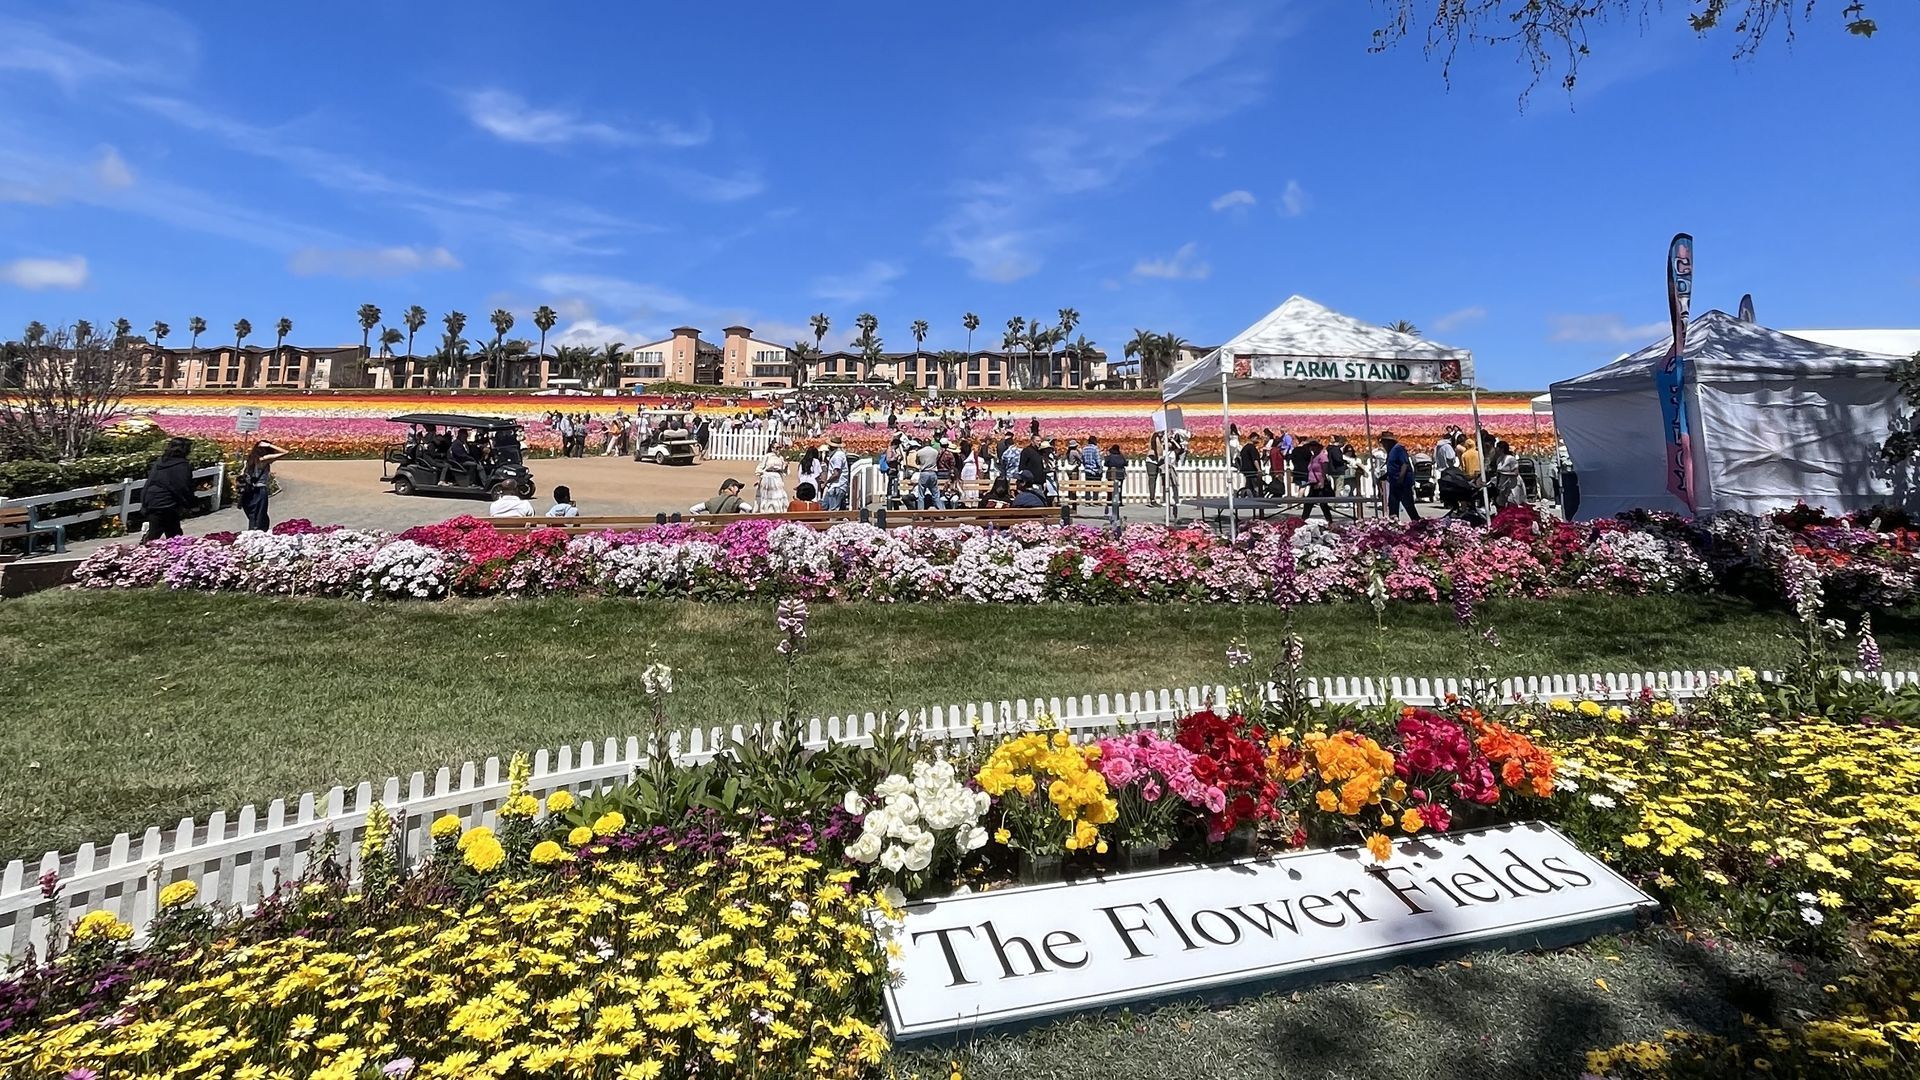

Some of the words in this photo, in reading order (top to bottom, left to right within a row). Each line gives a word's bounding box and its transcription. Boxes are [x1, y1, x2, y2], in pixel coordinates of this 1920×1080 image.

[1283, 359, 1339, 379] FARM
[1344, 362, 1411, 381] STAND
[911, 920, 1089, 988] The
[1093, 888, 1378, 960] Flower
[1364, 848, 1592, 916] Fields
